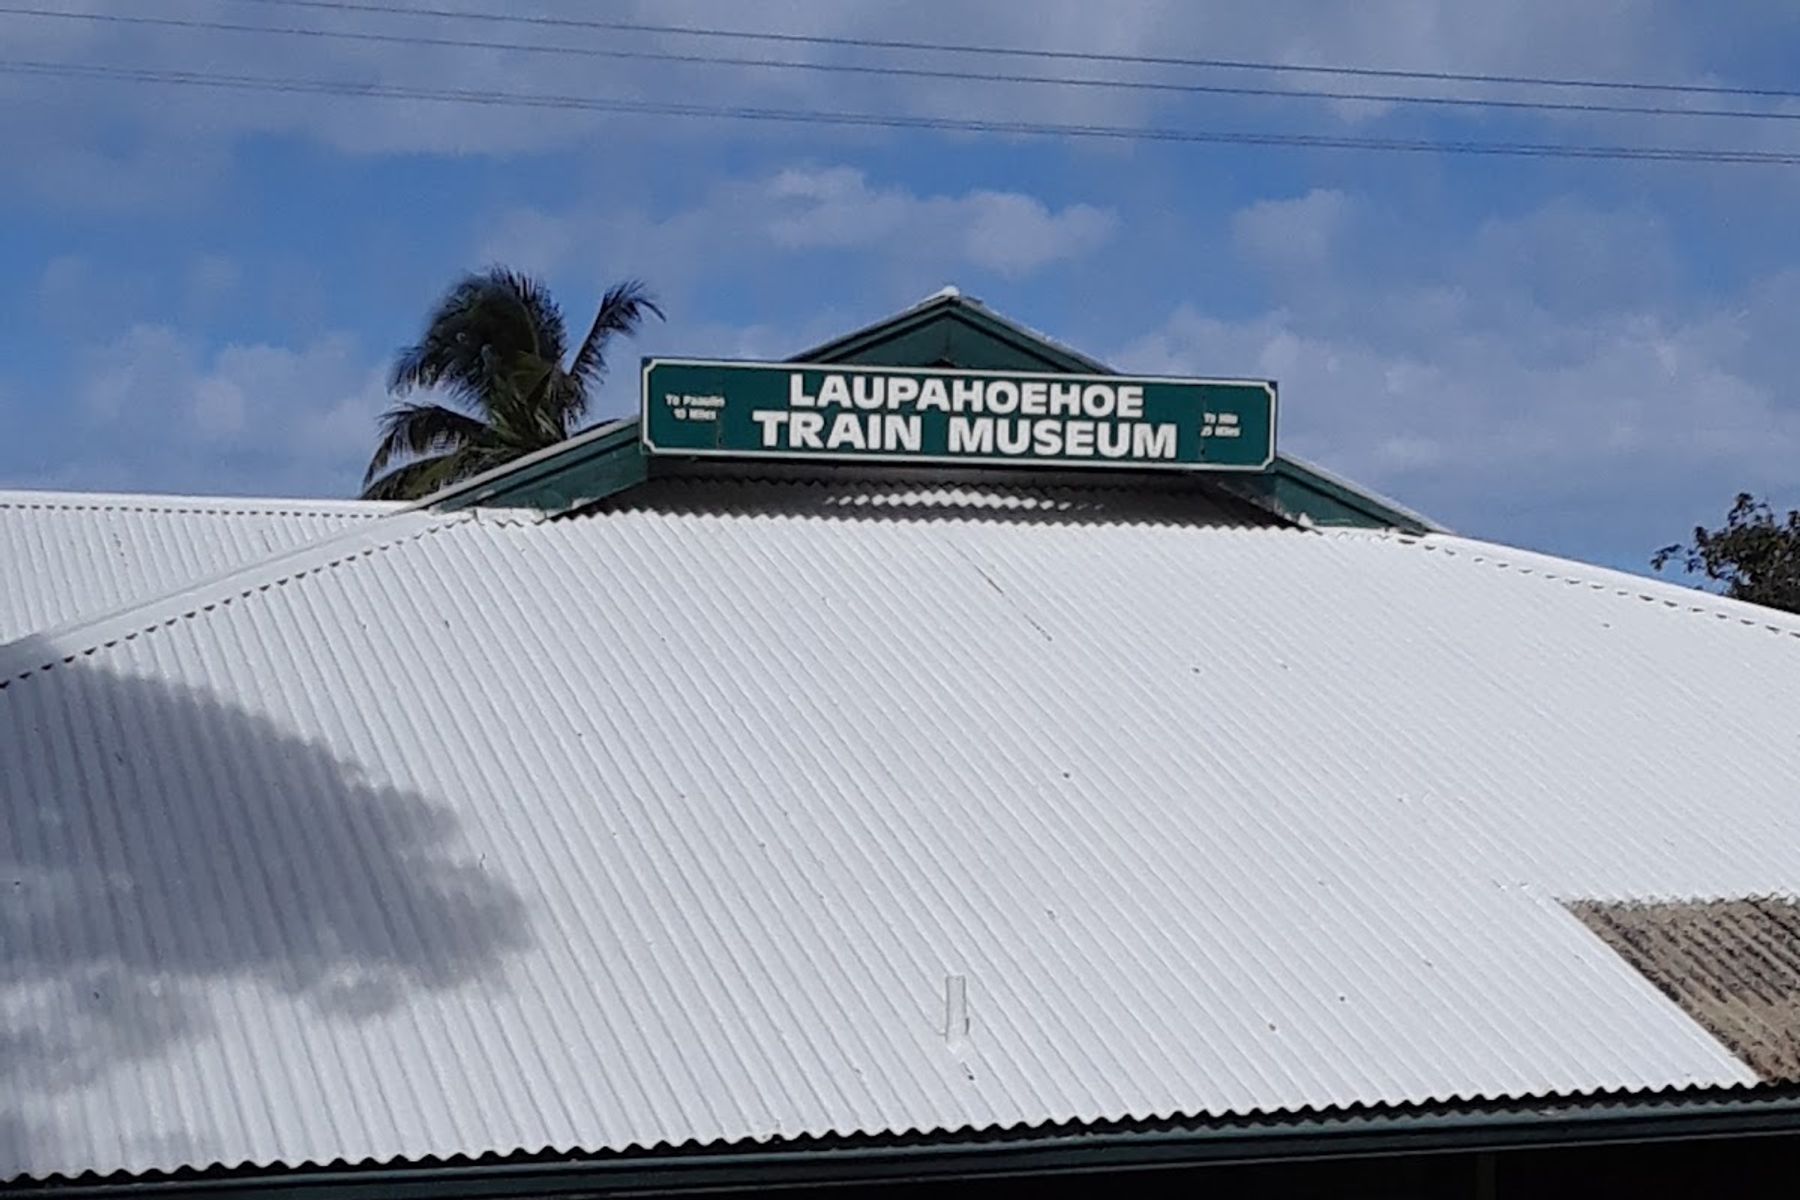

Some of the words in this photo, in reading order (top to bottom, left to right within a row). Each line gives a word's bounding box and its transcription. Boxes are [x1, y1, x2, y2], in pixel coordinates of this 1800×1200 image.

[789, 372, 1145, 418] LAUPAHOEHOE
[751, 409, 923, 452] TRAIN
[947, 415, 1178, 460] MUSEUM
